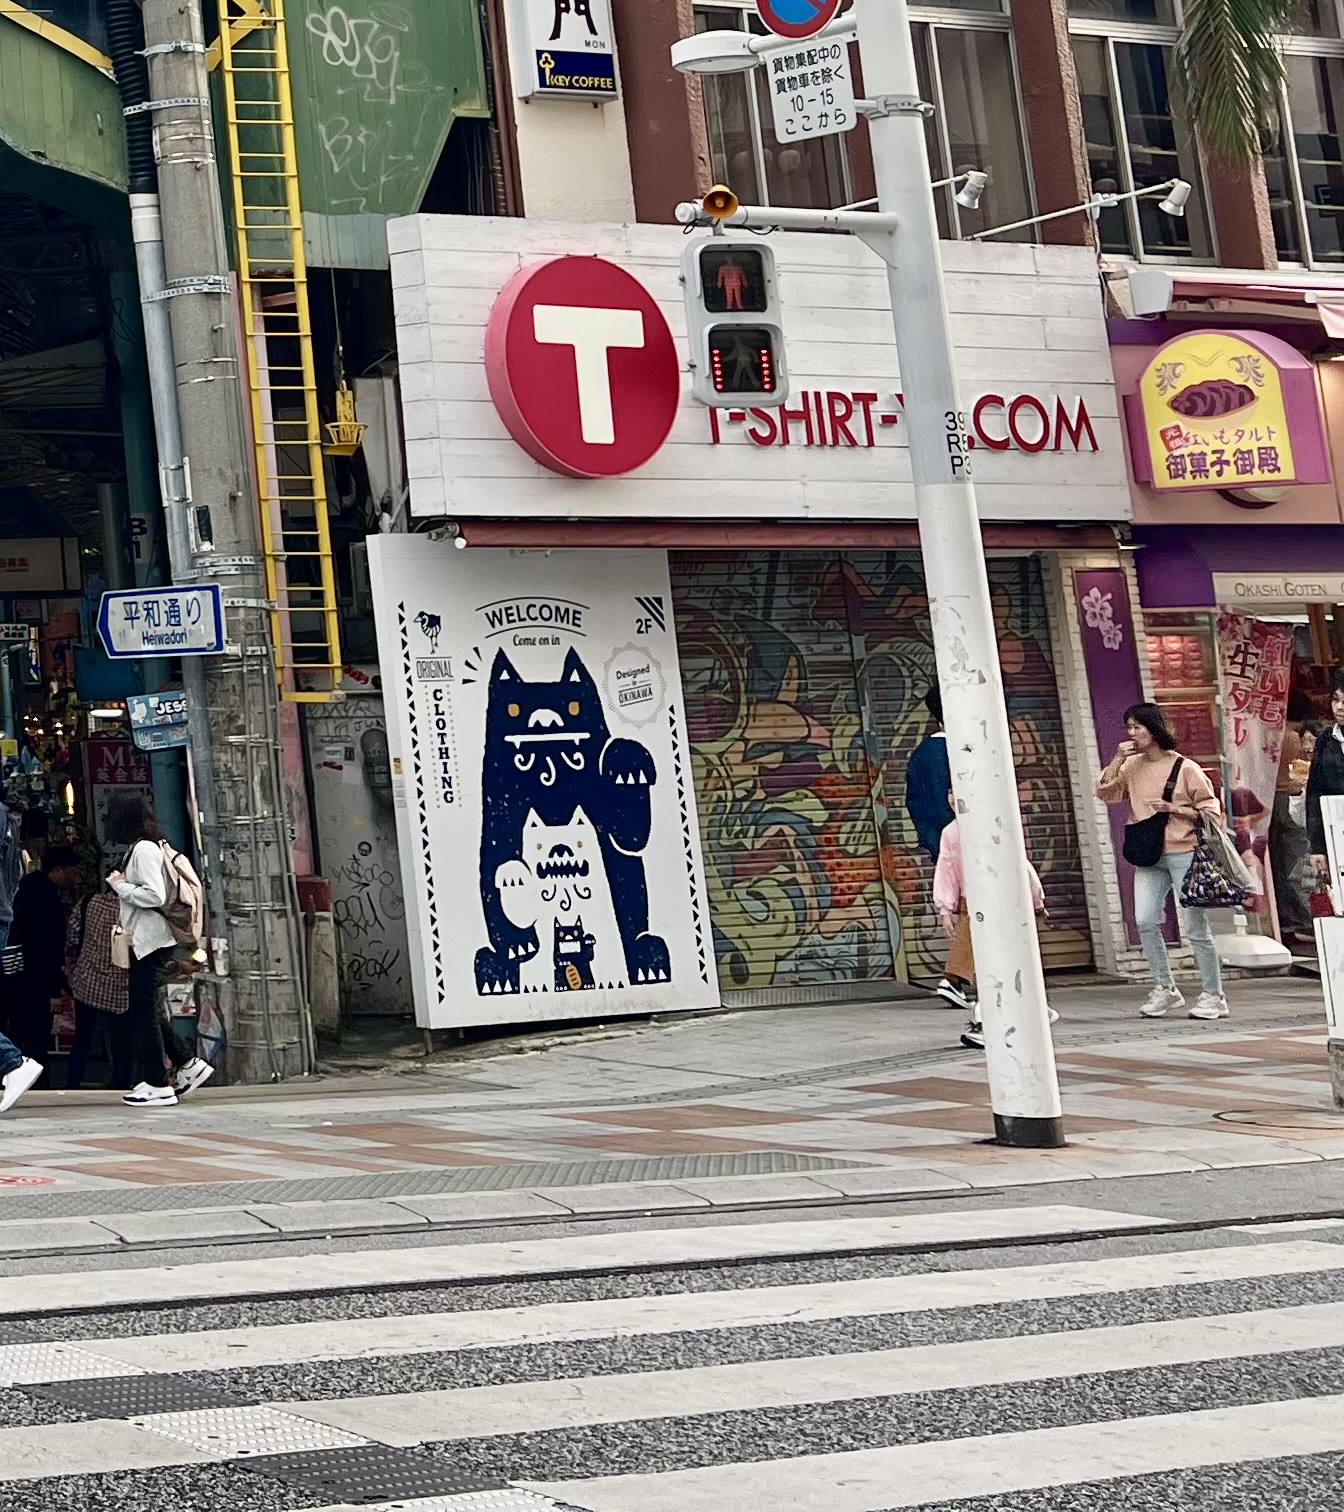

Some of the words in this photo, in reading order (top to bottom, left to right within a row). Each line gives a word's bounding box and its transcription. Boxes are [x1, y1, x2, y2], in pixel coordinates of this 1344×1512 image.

[584, 39, 606, 49] MON
[772, 44, 842, 73] 貨物集配中の
[572, 77, 614, 89] COFFEE
[774, 65, 846, 94] 貨物車を除く
[784, 108, 848, 136] ここから
[532, 304, 646, 445] T
[944, 411, 966, 432] 39
[1165, 446, 1282, 480] 御菓子御殿
[1234, 582, 1282, 597] OKASHI
[1283, 581, 1327, 597] GOTEN
[123, 598, 203, 630] 平和通り
[484, 602, 584, 629] WELCOME
[635, 617, 653, 636] 2F
[141, 628, 188, 647] Heiwadori
[512, 634, 538, 648] Come
[538, 635, 550, 647] on
[550, 634, 561, 647] in
[415, 659, 455, 680] ORIGINAL
[615, 663, 651, 681] Designed
[1258, 635, 1292, 724] 紅いも
[617, 686, 654, 704] OKINAWA
[431, 688, 455, 805] CLOTHING
[95, 767, 148, 784] 英会話
